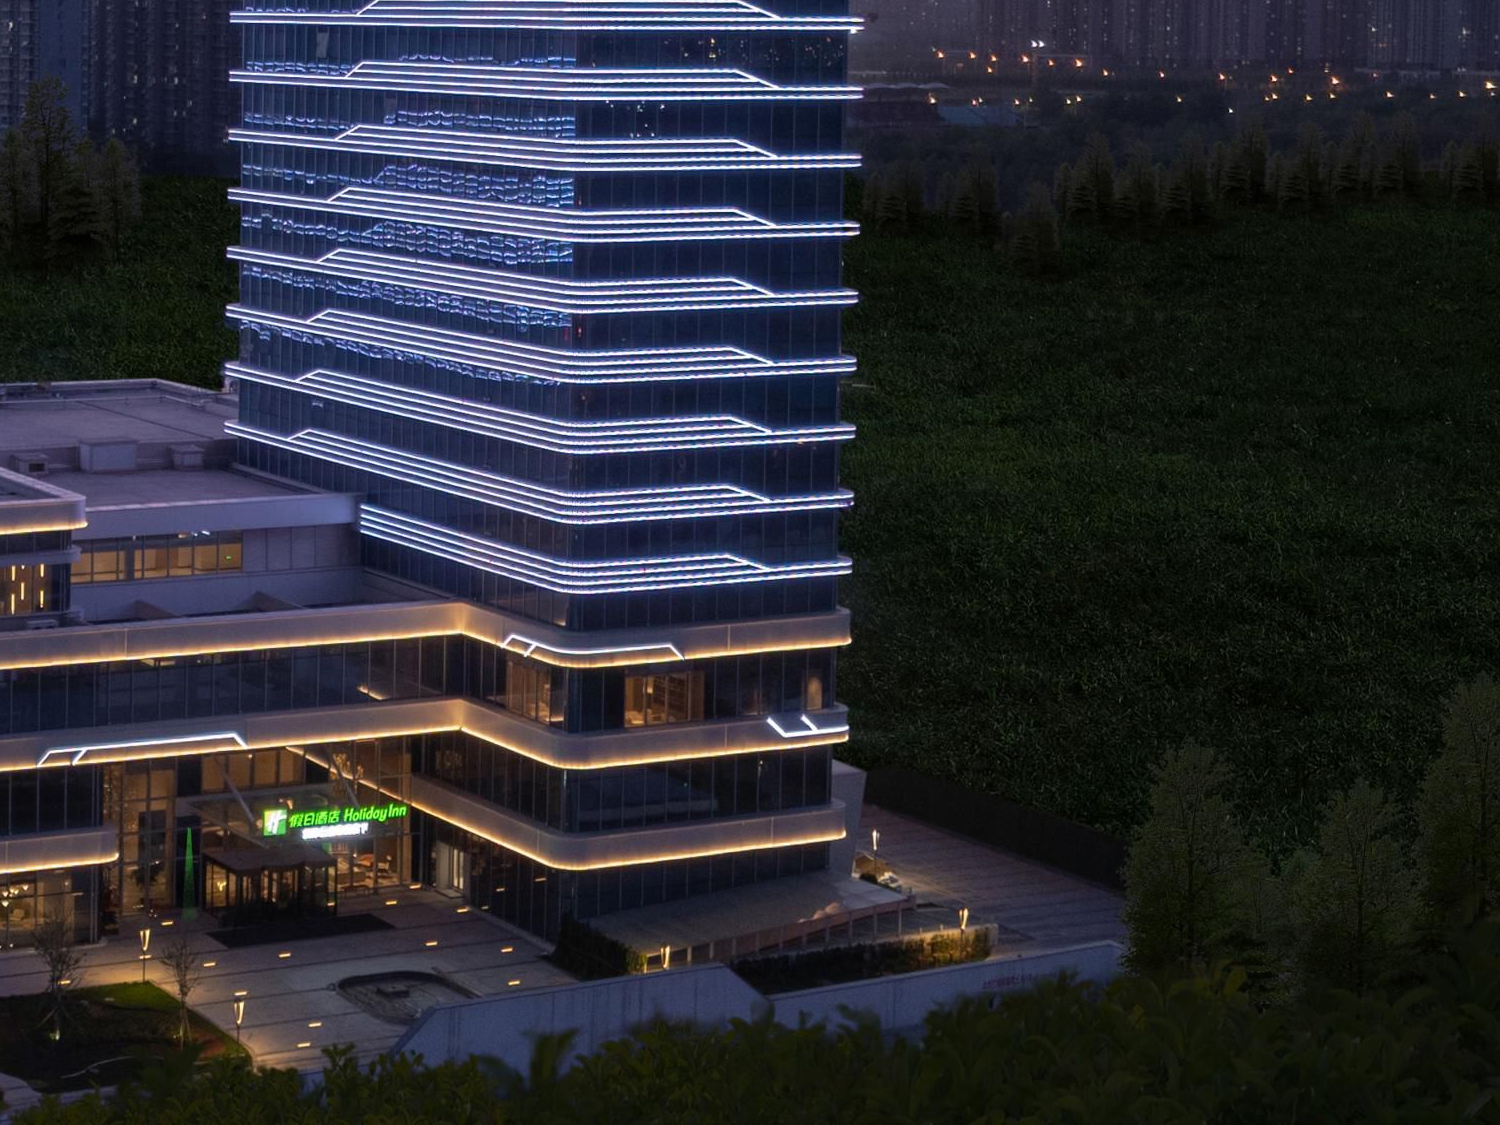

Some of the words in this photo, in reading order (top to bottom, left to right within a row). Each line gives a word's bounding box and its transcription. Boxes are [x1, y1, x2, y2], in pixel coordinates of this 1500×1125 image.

[288, 811, 340, 828] 假日酒店
[344, 806, 387, 822] Holiday
[387, 803, 407, 817] Inn
